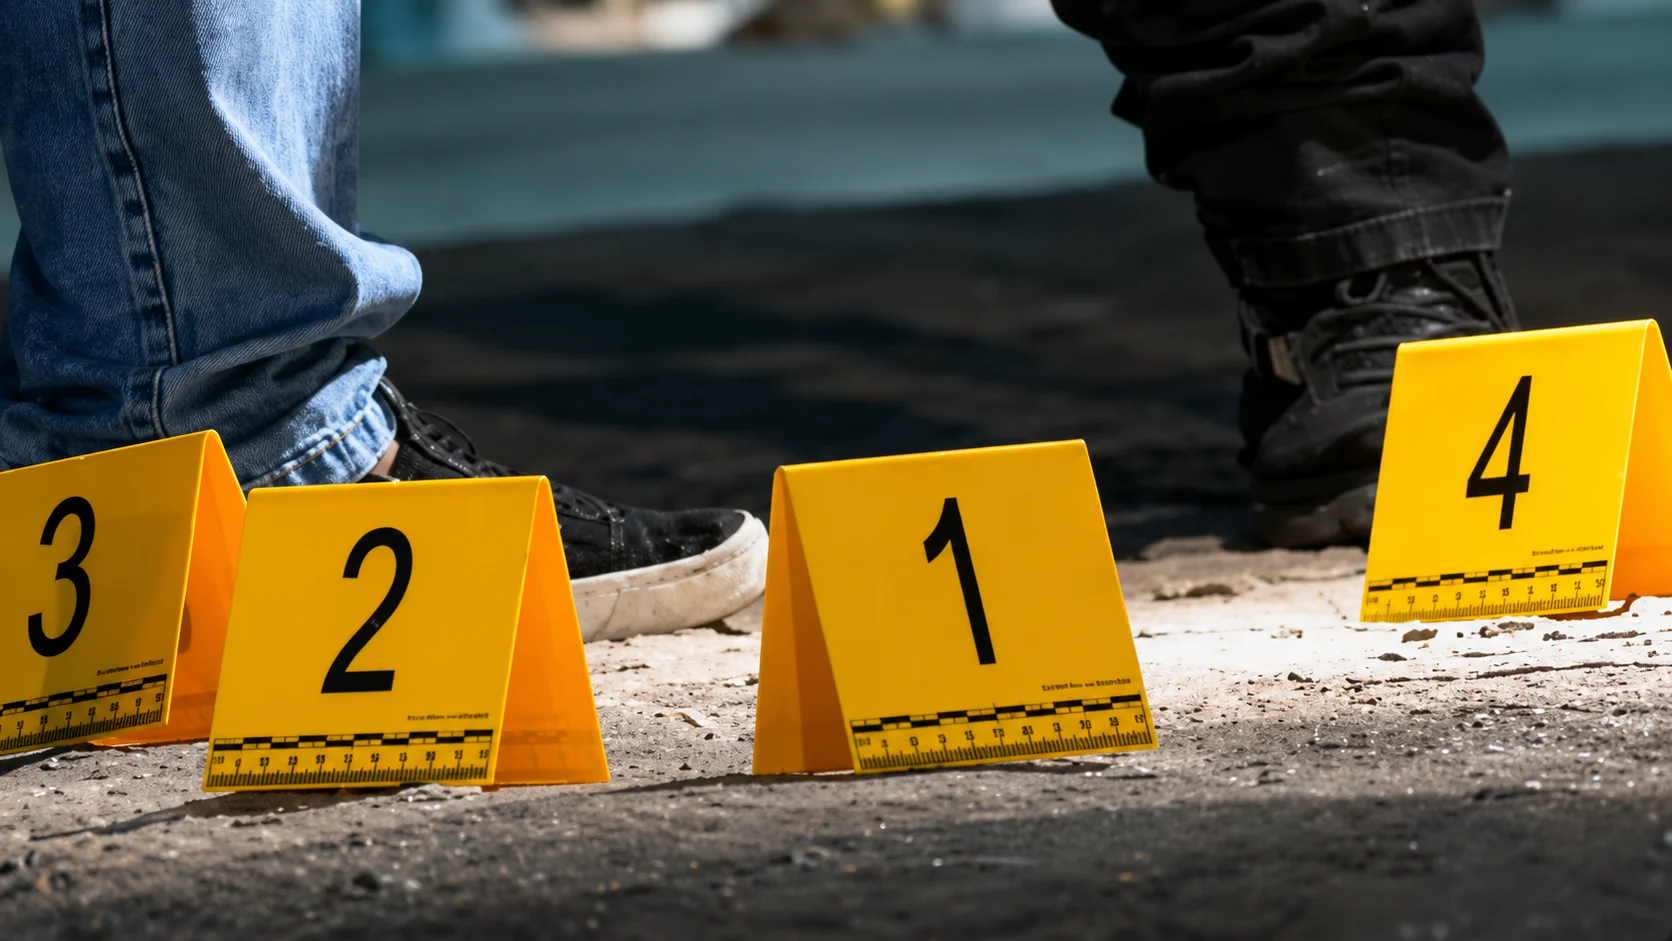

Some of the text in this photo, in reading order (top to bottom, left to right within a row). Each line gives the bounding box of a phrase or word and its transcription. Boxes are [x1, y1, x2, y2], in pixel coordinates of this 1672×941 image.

[1466, 376, 1532, 529] 4
[27, 496, 96, 657] 3
[321, 527, 412, 693] 2
[924, 498, 996, 665] 1
